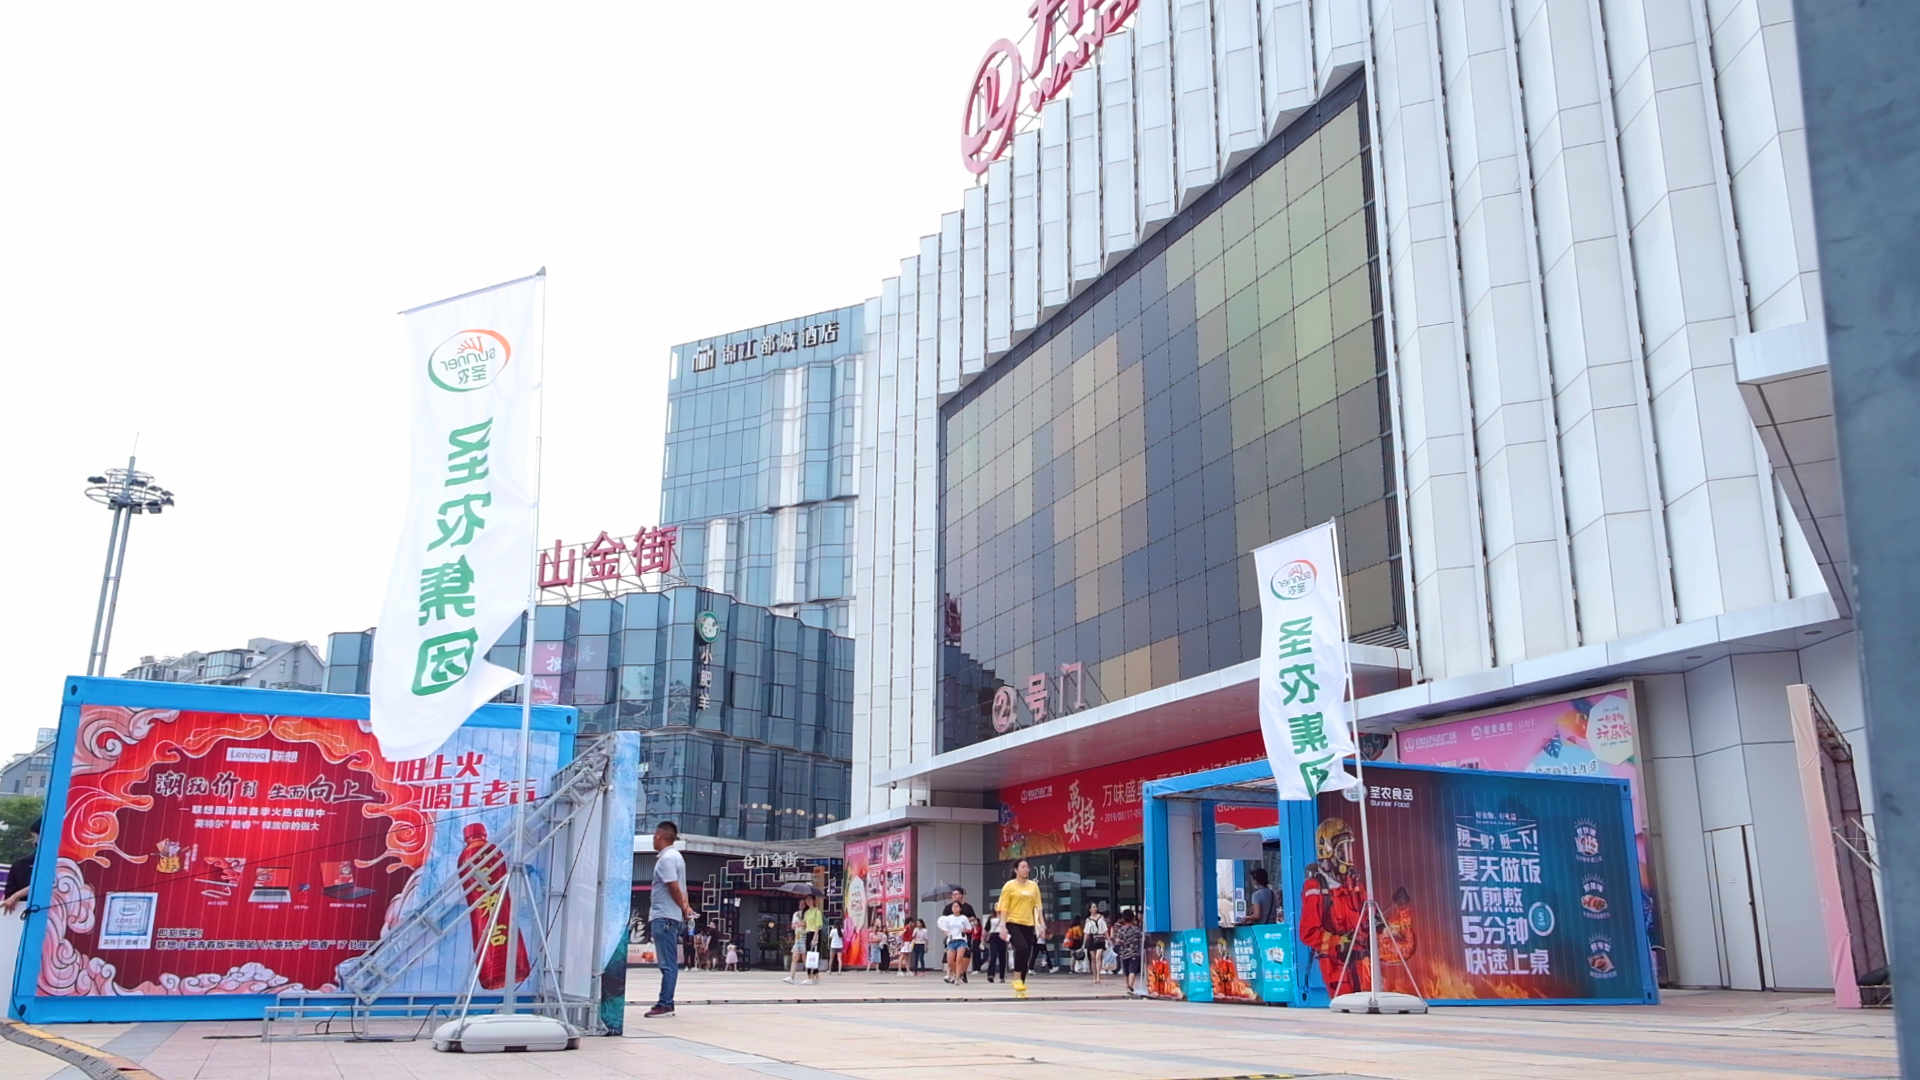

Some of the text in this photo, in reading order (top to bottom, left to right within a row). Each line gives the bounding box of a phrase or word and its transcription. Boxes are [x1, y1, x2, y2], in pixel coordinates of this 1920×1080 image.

[698, 645, 713, 711] 小肥羊
[393, 751, 484, 783] 怕上火
[268, 774, 377, 803] 生而向上
[421, 779, 538, 811] 喝王老吉
[1369, 785, 1414, 801] 圣农食品
[744, 851, 799, 870] 仓山金街
[1458, 855, 1542, 884] 夏天做饭
[1459, 886, 1524, 914] 不煎熬
[1462, 916, 1530, 946] 5分钟
[1465, 948, 1551, 976] 快速上桌
